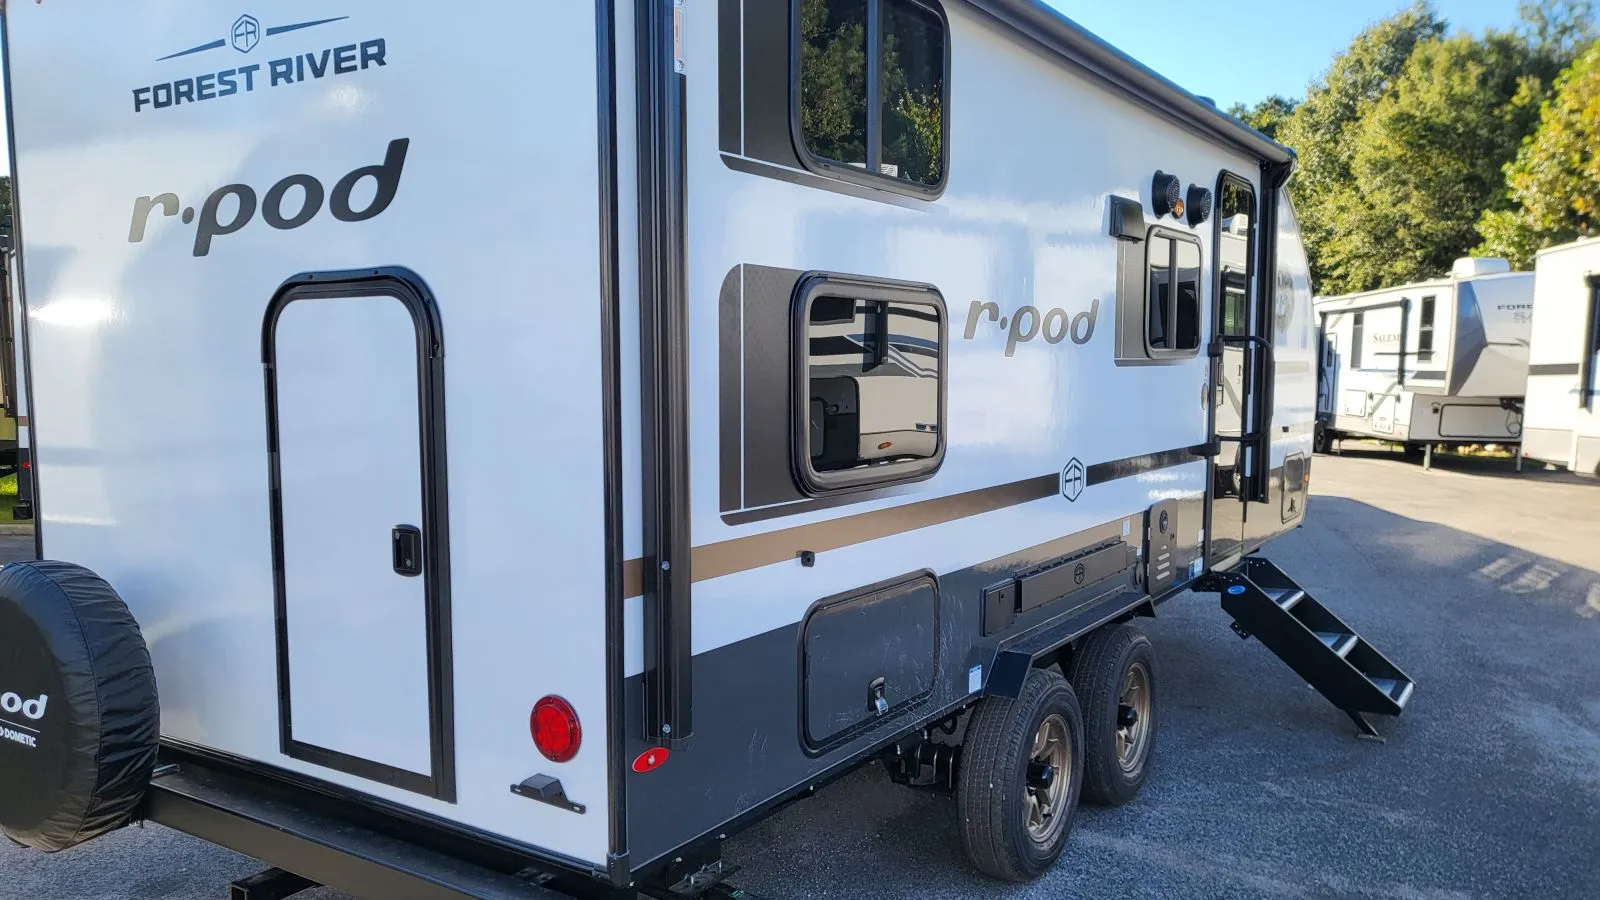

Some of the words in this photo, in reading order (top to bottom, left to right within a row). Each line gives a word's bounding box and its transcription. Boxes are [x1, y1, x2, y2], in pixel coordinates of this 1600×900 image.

[132, 64, 260, 112] FOREST
[268, 38, 387, 87] RIVER
[4, 727, 37, 748] DOMETIC
